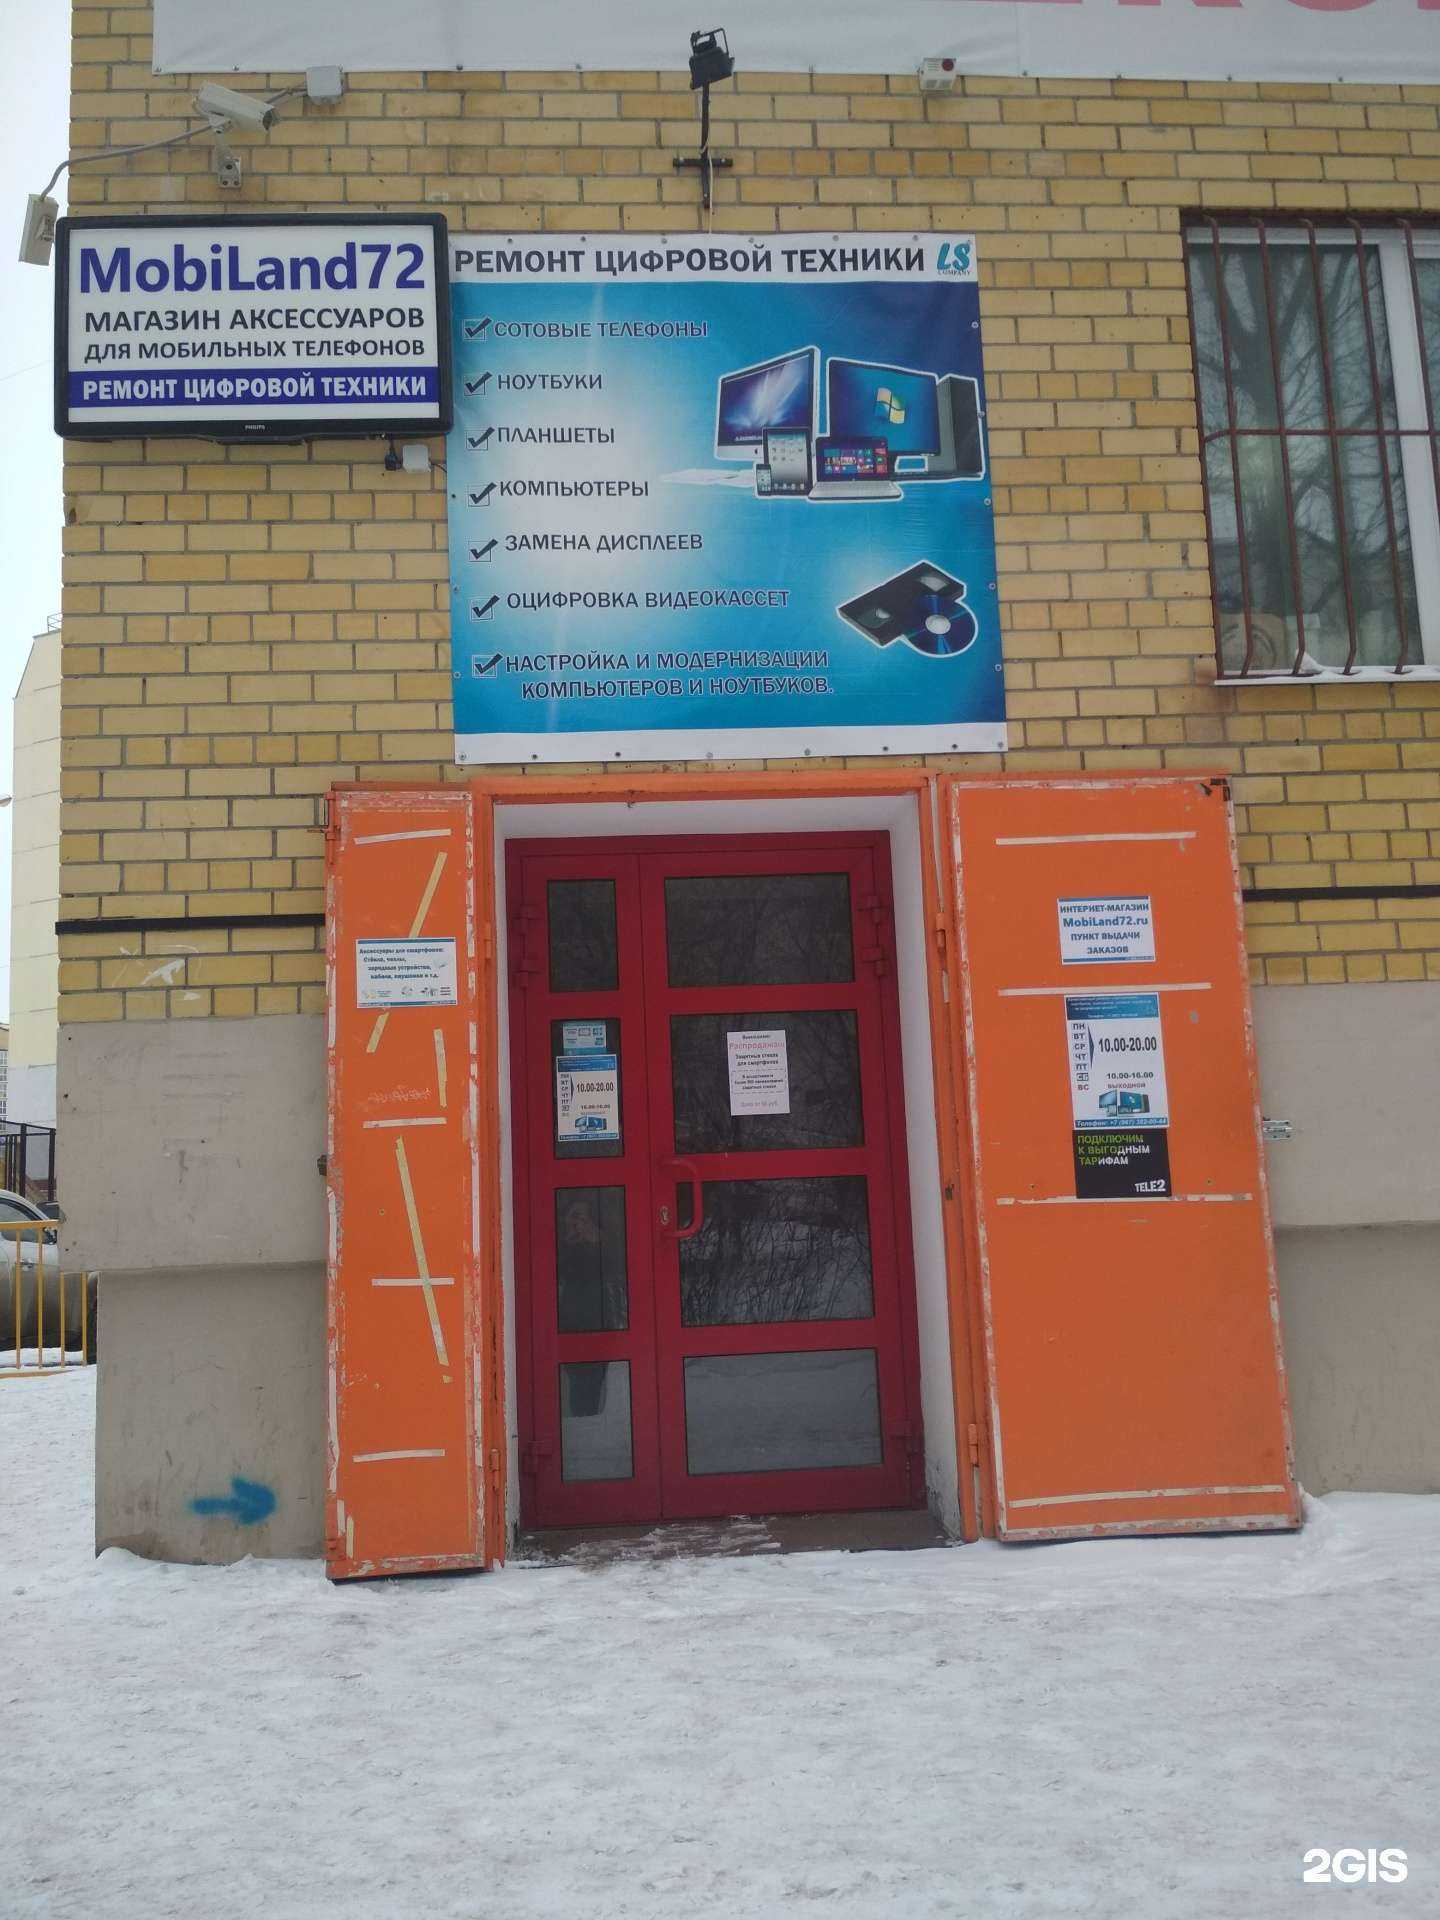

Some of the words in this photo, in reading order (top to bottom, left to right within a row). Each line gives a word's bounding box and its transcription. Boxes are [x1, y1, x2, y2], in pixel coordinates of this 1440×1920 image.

[455, 250, 585, 273] РЕМОНТ
[596, 243, 772, 276] ЦИФРОВОЙ
[781, 248, 925, 272] ТЕХНИКИ
[936, 242, 972, 271] LS
[79, 242, 425, 293] MobiLand72
[84, 310, 220, 332] МАГАЗИН
[229, 307, 425, 330] АКСЕССУАРОВ
[494, 322, 591, 338] СОТОВЫЕ
[597, 321, 708, 337] ТЕЛЕФОНЫ
[84, 342, 131, 364] ДЛЯ
[138, 340, 287, 360] МОБИЛЬНЫХ
[294, 338, 425, 357] ТЕЛЕФОНОВ
[83, 379, 178, 400] РЕМОНТ
[184, 371, 315, 402] ЦИФРОВОЙ
[321, 376, 426, 397] ТЕХНИКИ
[498, 374, 602, 390] НОУТБУКИ
[498, 427, 615, 443] ПЛАНШЕТЫ
[500, 480, 649, 497] КОМПЬЮТЕРЫ
[505, 534, 591, 551] ЗАМЕНА
[596, 534, 703, 553] ДИСПЛЕЕВ
[507, 592, 639, 611] ОЦИФРОВКА
[646, 590, 790, 610] ВИДЕОКАССЕТ
[505, 650, 629, 672] НАСТРОЙКА
[637, 653, 649, 669] И
[657, 651, 829, 670] МОДЕРНИЗАЦИИ
[522, 679, 682, 698] КОМПЬЮТЕРОВ
[689, 679, 702, 695] И
[710, 677, 834, 695] НОУТБУКОВ.
[1060, 904, 1149, 913] ИНТЕРНЕТ-МАГАЗИН
[1063, 916, 1148, 927] MobiLand72.ru
[1071, 933, 1099, 941] ПУНКТ
[1102, 931, 1140, 941] ВЫДАЧИ
[1087, 946, 1128, 954] ЗАКАЗОВ
[1098, 1037, 1157, 1053] 10.00-20.00
[576, 1082, 614, 1093] 10.00-20.00
[1077, 1135, 1144, 1145] ПОДКЛЮЧИМ
[1078, 1146, 1085, 1154] К
[1088, 1145, 1150, 1156] ВЫГОДНЫМ
[1080, 1156, 1129, 1166] ТАРИФАМ
[1135, 1179, 1166, 1193] TELE2
